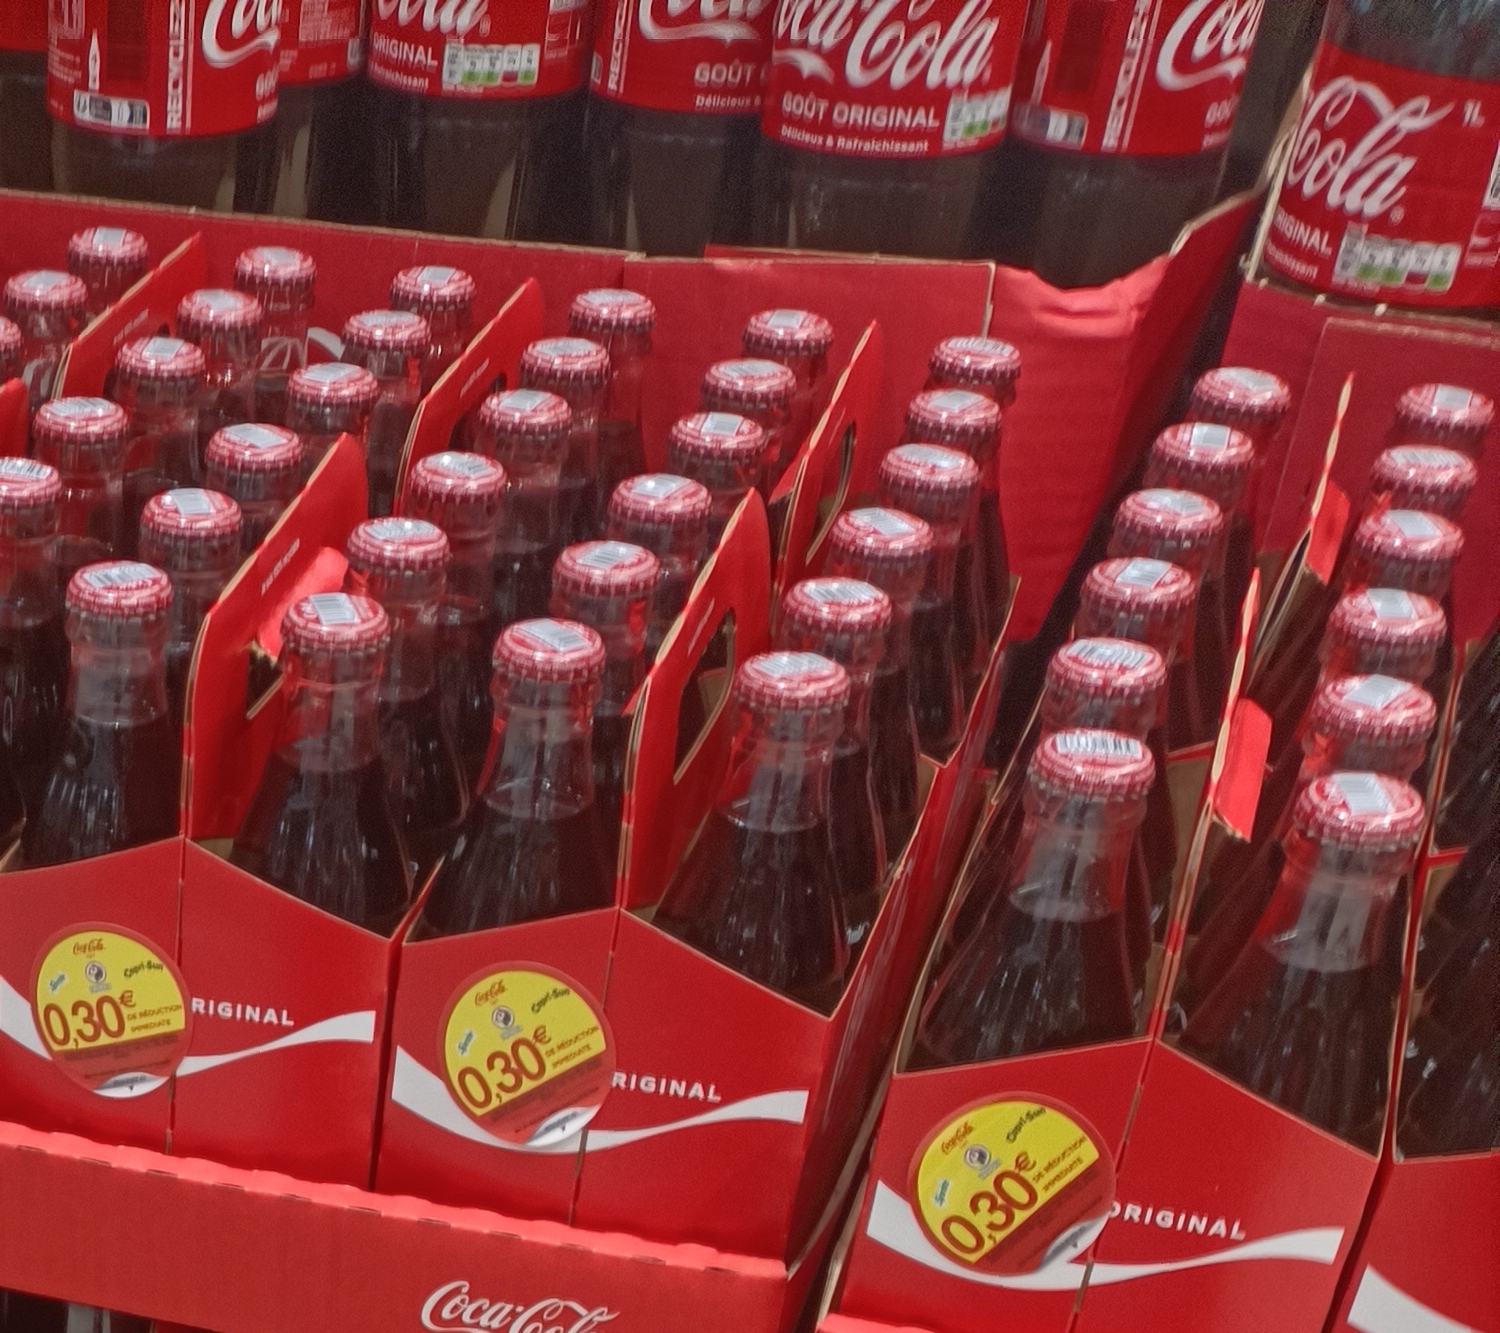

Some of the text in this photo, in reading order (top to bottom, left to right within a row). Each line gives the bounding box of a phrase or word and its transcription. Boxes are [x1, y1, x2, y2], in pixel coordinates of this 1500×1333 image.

[831, 101, 941, 130] ORIGINAL
[191, 997, 297, 1028] RIGINAL
[611, 1069, 723, 1104] RIGINAL
